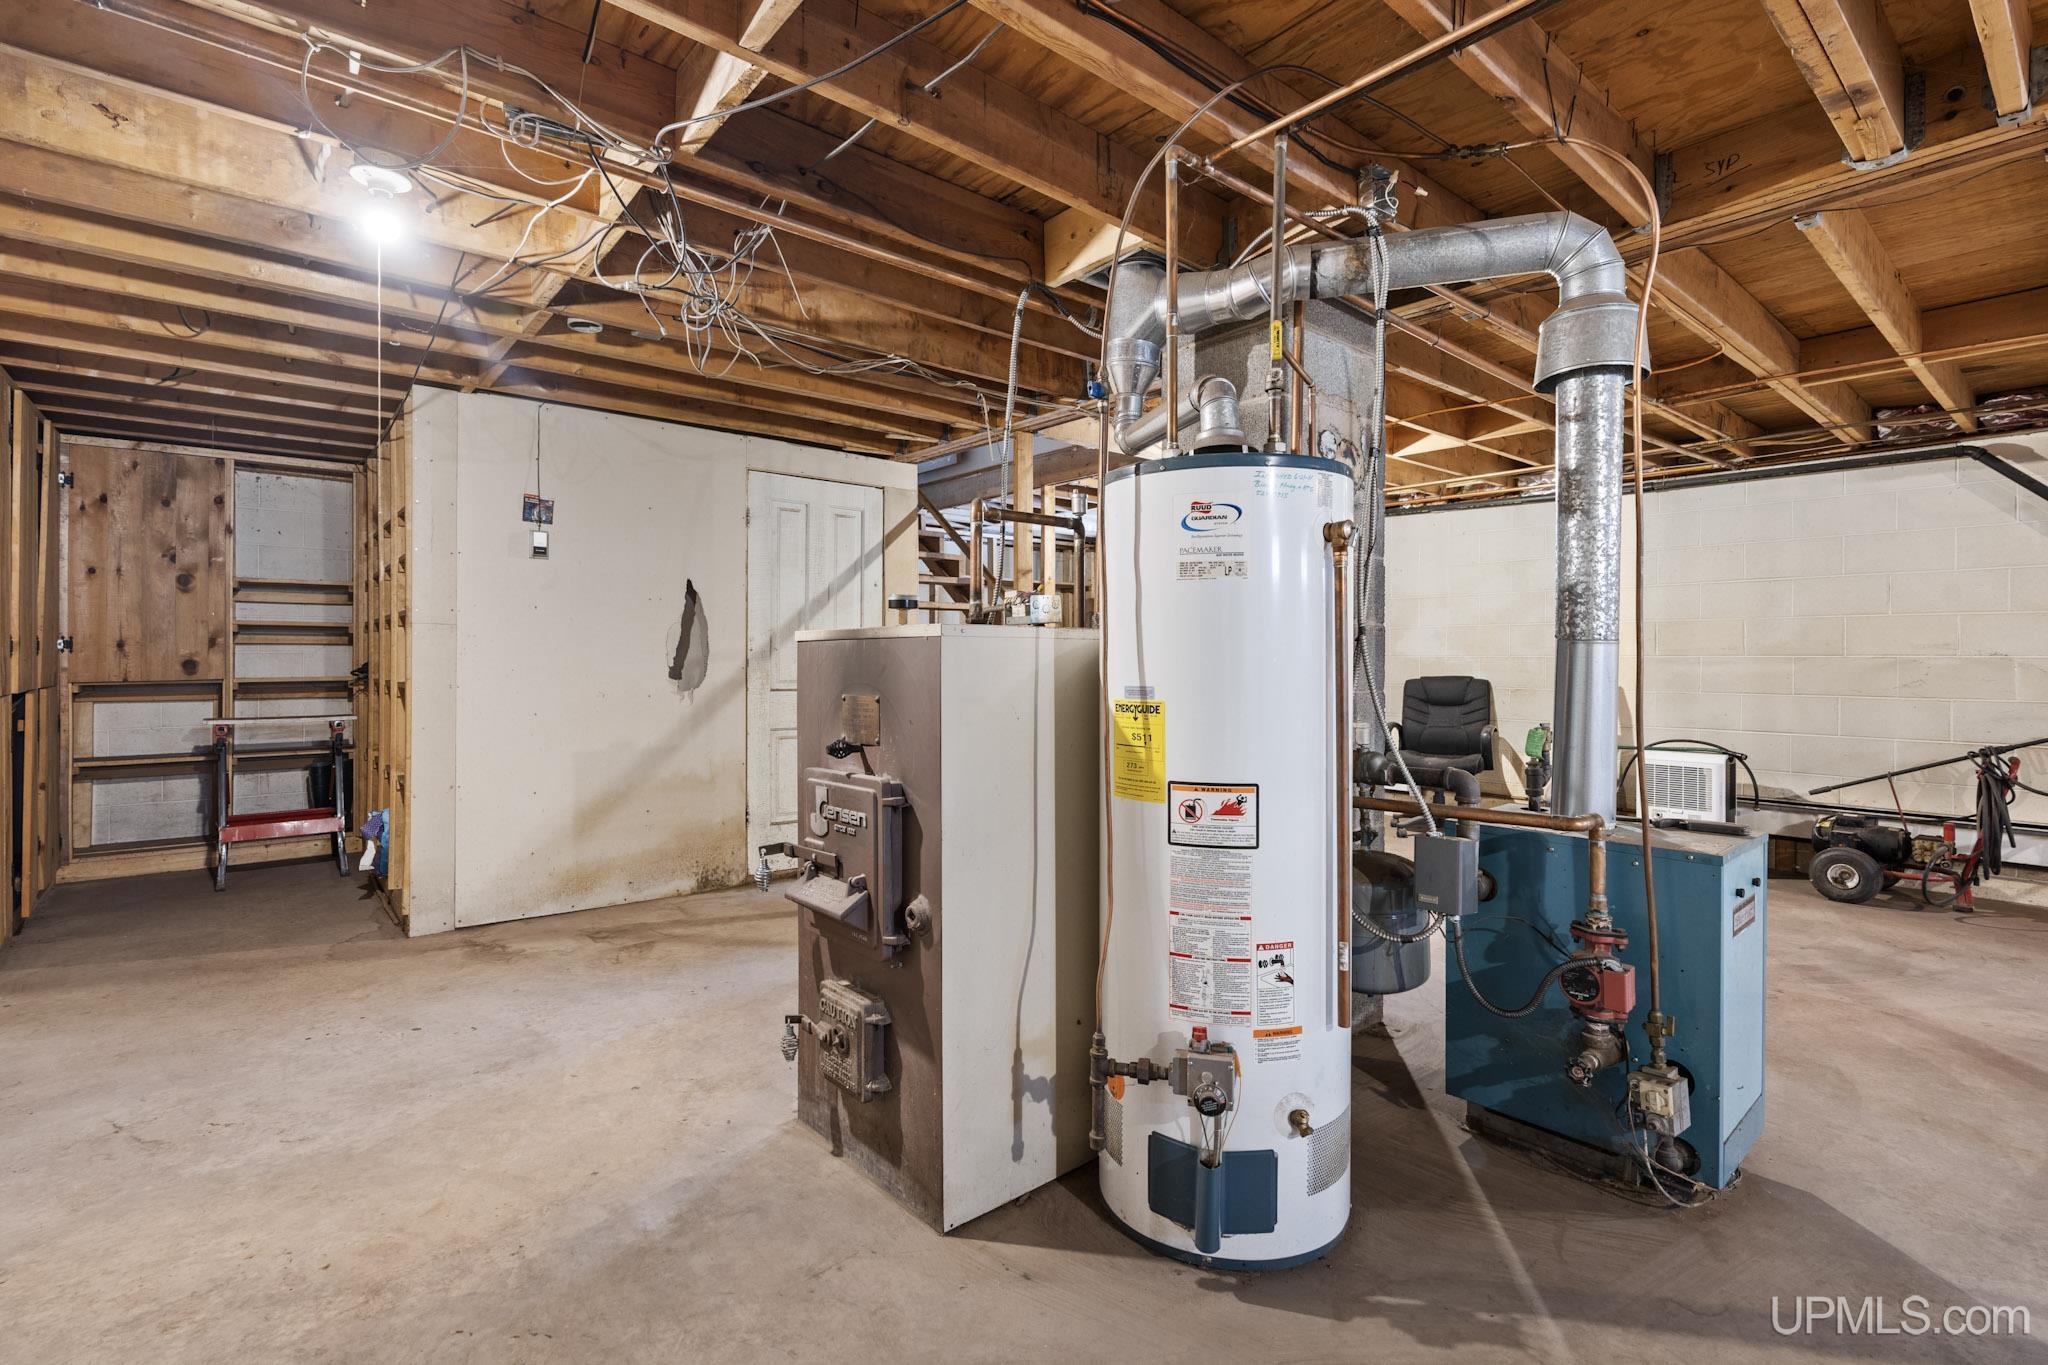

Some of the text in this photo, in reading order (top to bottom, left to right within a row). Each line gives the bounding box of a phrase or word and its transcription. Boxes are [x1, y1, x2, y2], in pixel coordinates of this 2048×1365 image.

[1703, 154, 1740, 178] SYP
[1180, 546, 1223, 554] PACEMAKER
[1131, 732, 1152, 742] $511
[820, 998, 859, 1031] CAUTION
